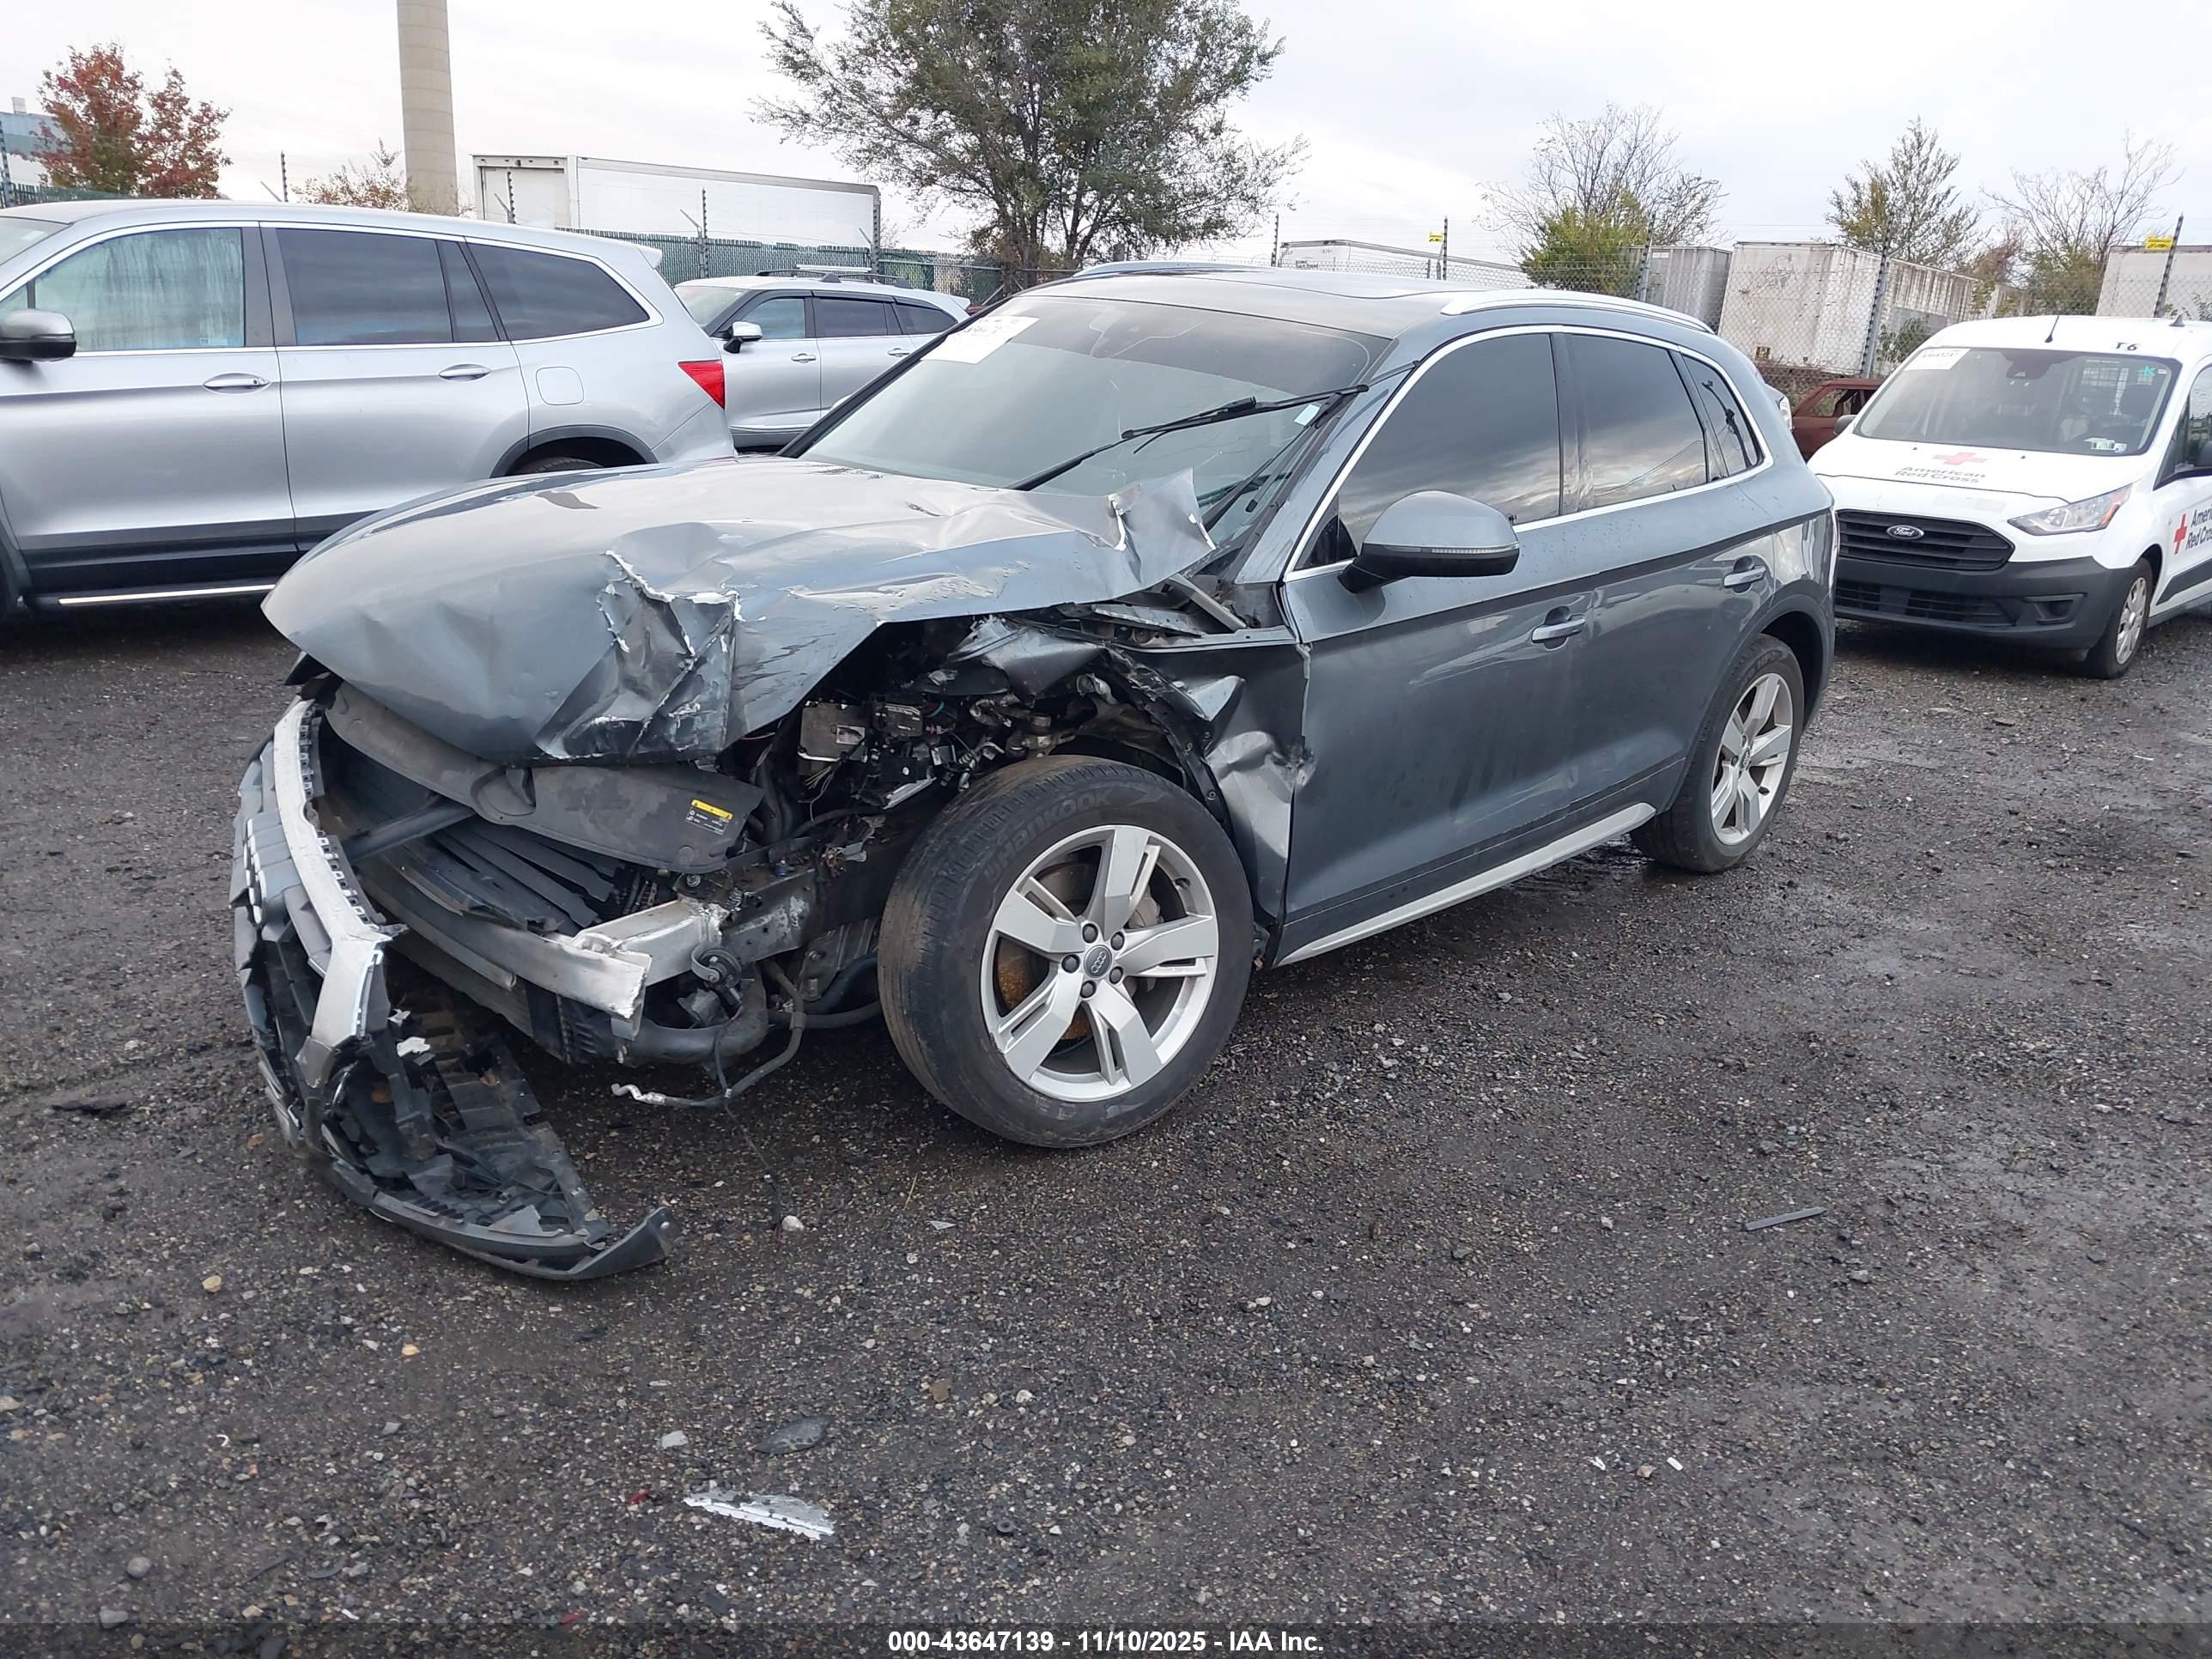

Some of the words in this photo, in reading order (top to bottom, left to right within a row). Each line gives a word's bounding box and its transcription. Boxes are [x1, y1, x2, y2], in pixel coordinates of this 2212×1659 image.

[1894, 470, 1928, 478] Red
[1930, 473, 1979, 483] Cross
[1900, 466, 1986, 477] American
[2185, 528, 2201, 550] Red
